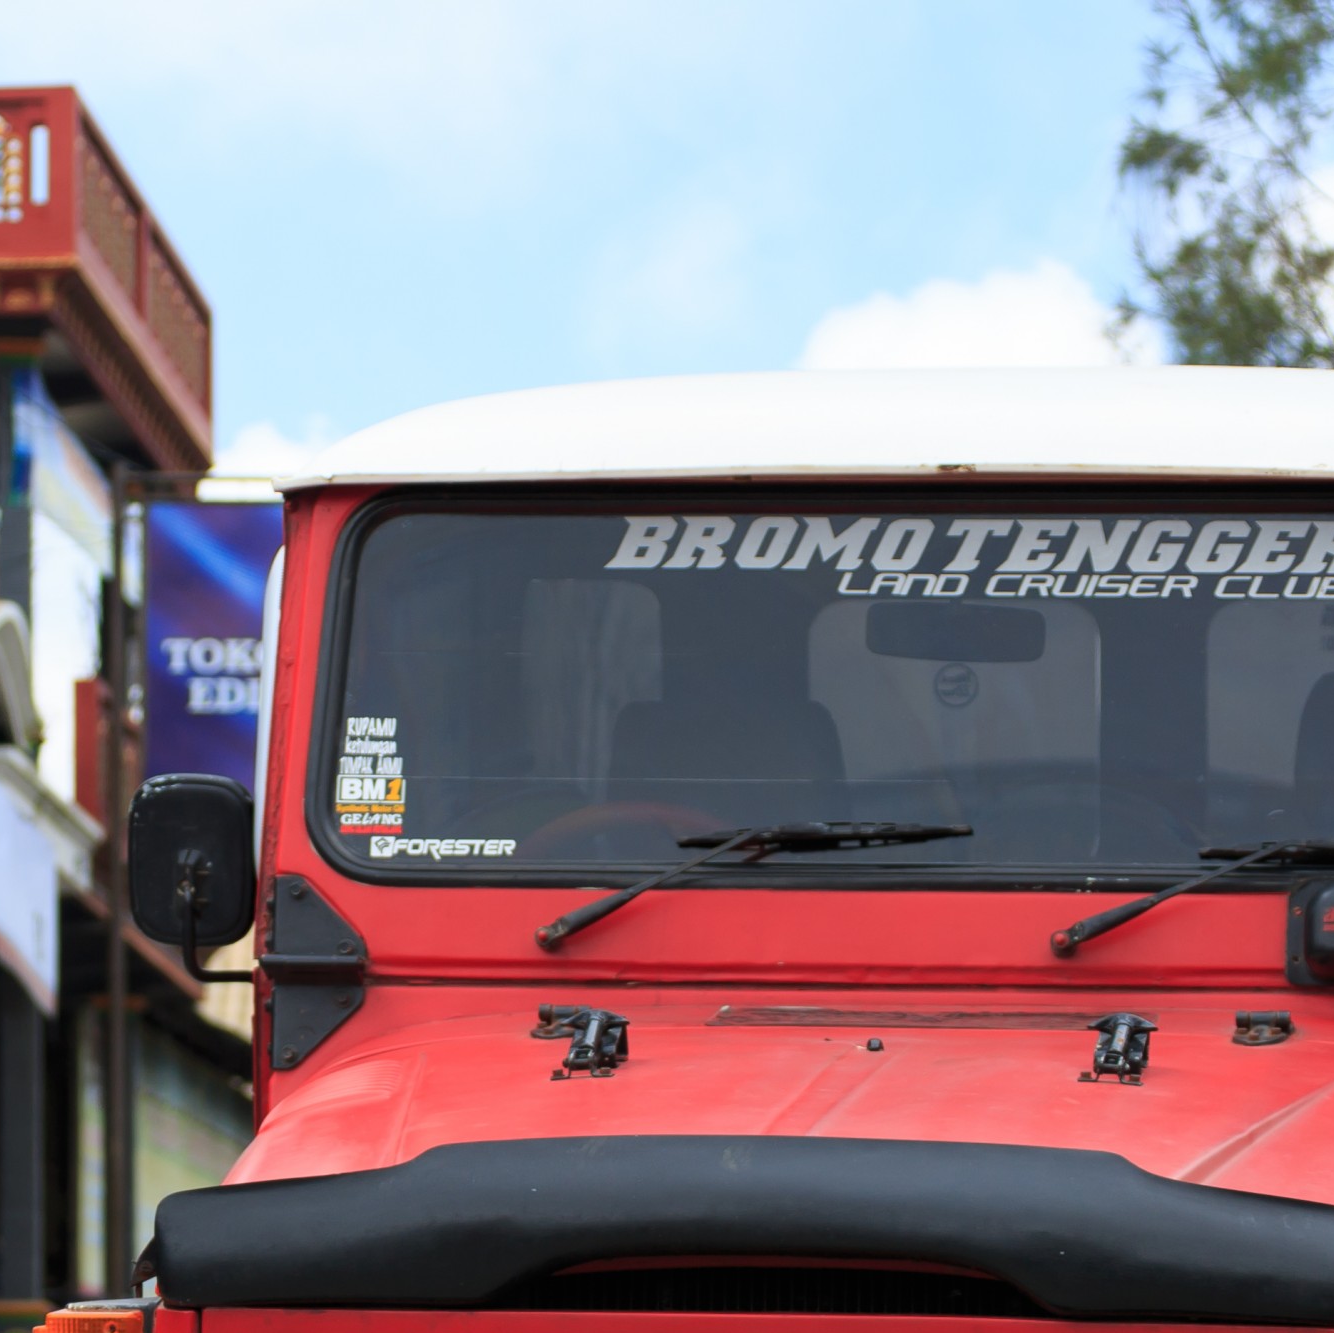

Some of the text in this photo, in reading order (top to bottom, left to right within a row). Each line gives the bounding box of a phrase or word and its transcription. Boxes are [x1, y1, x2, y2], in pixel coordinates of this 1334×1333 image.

[837, 572, 970, 597] LAND
[984, 574, 1199, 599] CRUISER
[341, 777, 402, 801] BM1
[340, 812, 403, 825] GELANG
[393, 838, 516, 861] FORESTER
